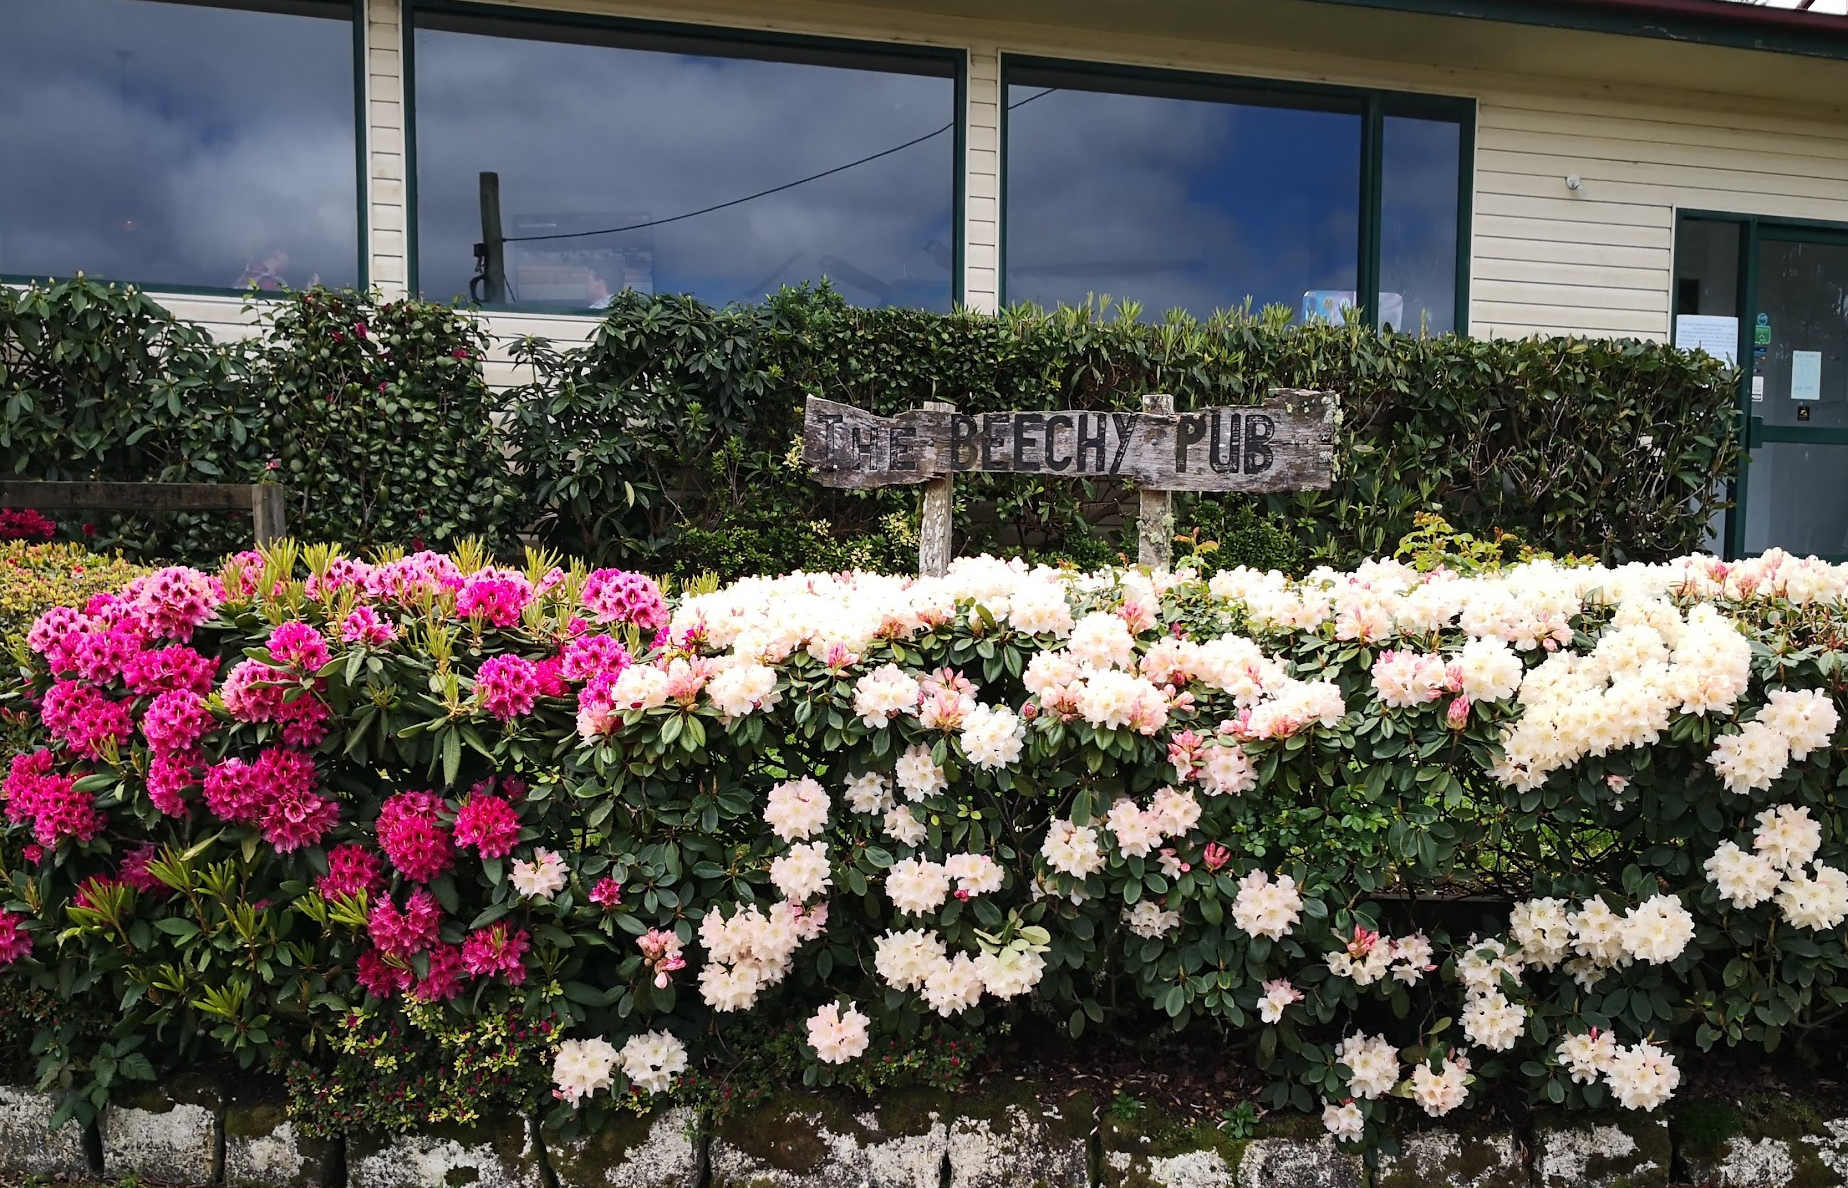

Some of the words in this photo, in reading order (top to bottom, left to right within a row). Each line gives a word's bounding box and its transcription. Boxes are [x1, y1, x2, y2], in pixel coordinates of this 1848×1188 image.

[818, 414, 916, 471] THE
[950, 413, 1138, 474] BEECHY
[1175, 412, 1275, 475] PUB
